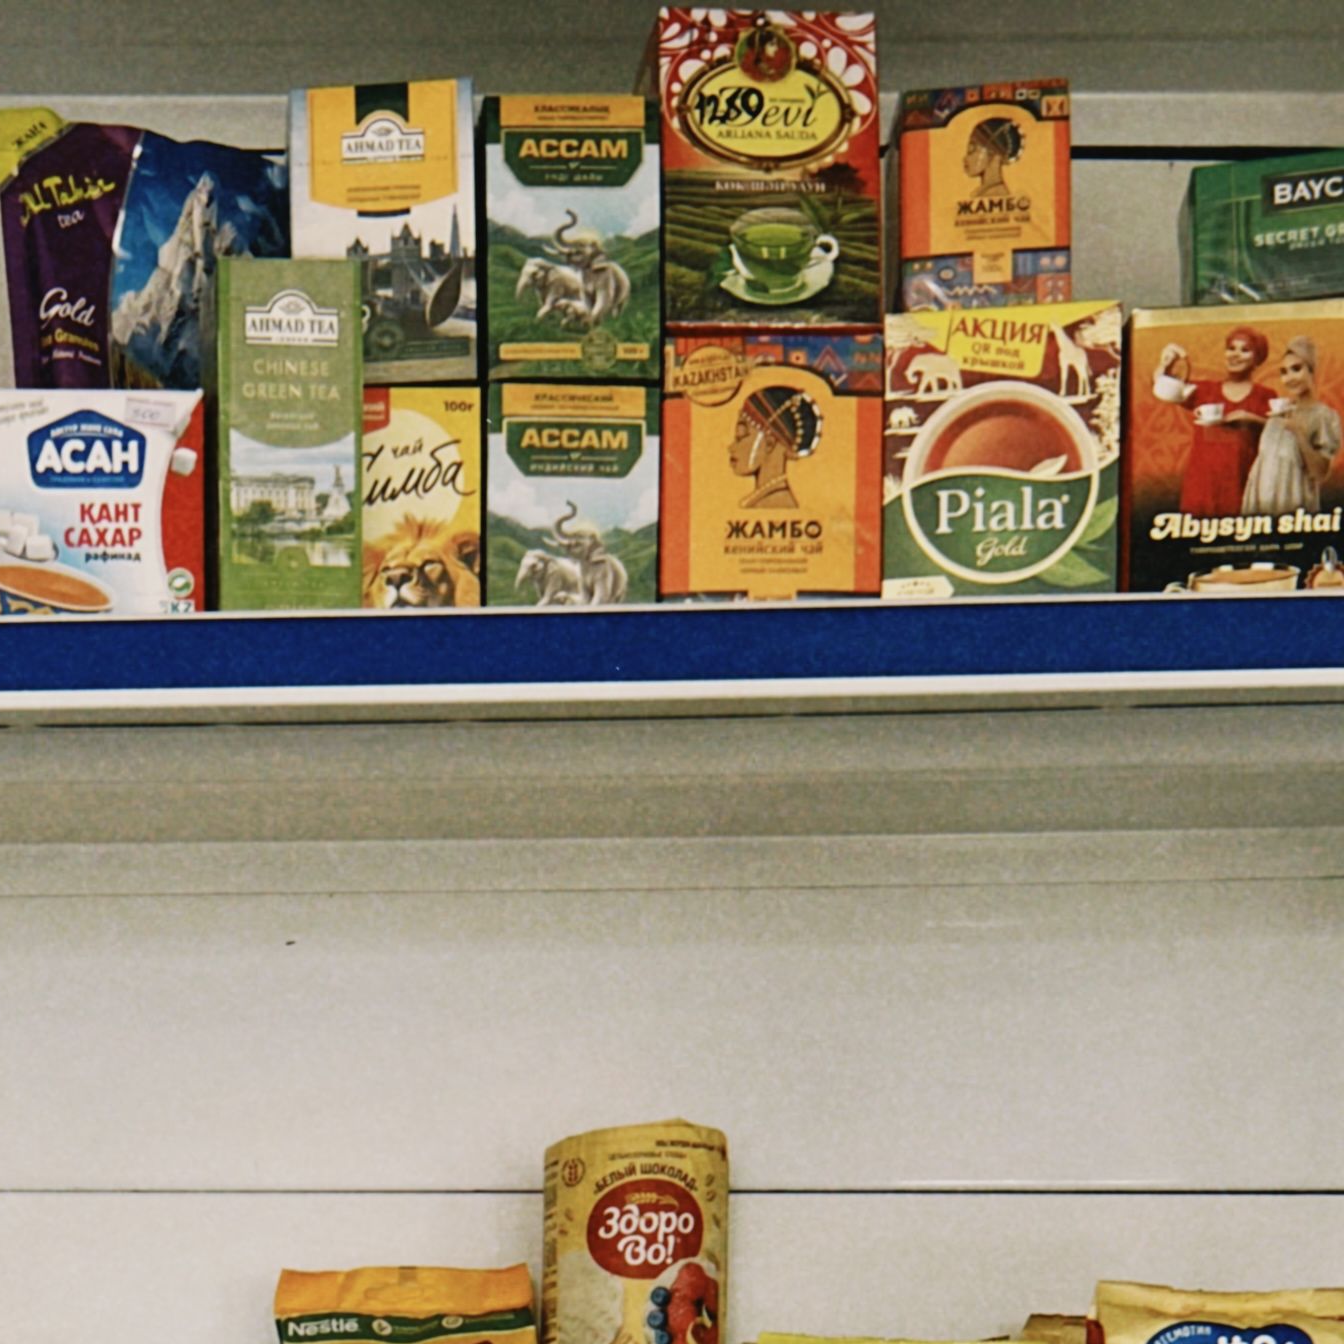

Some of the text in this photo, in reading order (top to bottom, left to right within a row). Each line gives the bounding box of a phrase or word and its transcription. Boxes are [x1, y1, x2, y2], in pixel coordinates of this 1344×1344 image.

[345, 137, 423, 155] AHMAD TEA
[519, 139, 628, 160] АССАМ
[956, 197, 1031, 215] ЖАМБО
[57, 210, 84, 228] tea
[1254, 226, 1320, 247] SECRET
[39, 287, 95, 328] Gold
[248, 317, 337, 335] AHMAD TEA
[954, 317, 1047, 345] АКЦИЯ
[253, 358, 329, 378] CHINESE
[242, 381, 340, 401] GREEN TEA
[391, 438, 424, 460] чай
[521, 430, 629, 450] АССАМ
[35, 439, 139, 474] АСАН
[80, 503, 142, 526] ҚАНТ
[935, 485, 1059, 536] Piala
[726, 520, 823, 540] ЖАМБО
[1150, 507, 1343, 546] Abysyn shai
[63, 527, 142, 548] САХАР
[85, 551, 141, 563] рафинад
[975, 536, 1027, 567] Gold
[598, 1206, 694, 1244] Здоро
[616, 1233, 675, 1266] Во!
